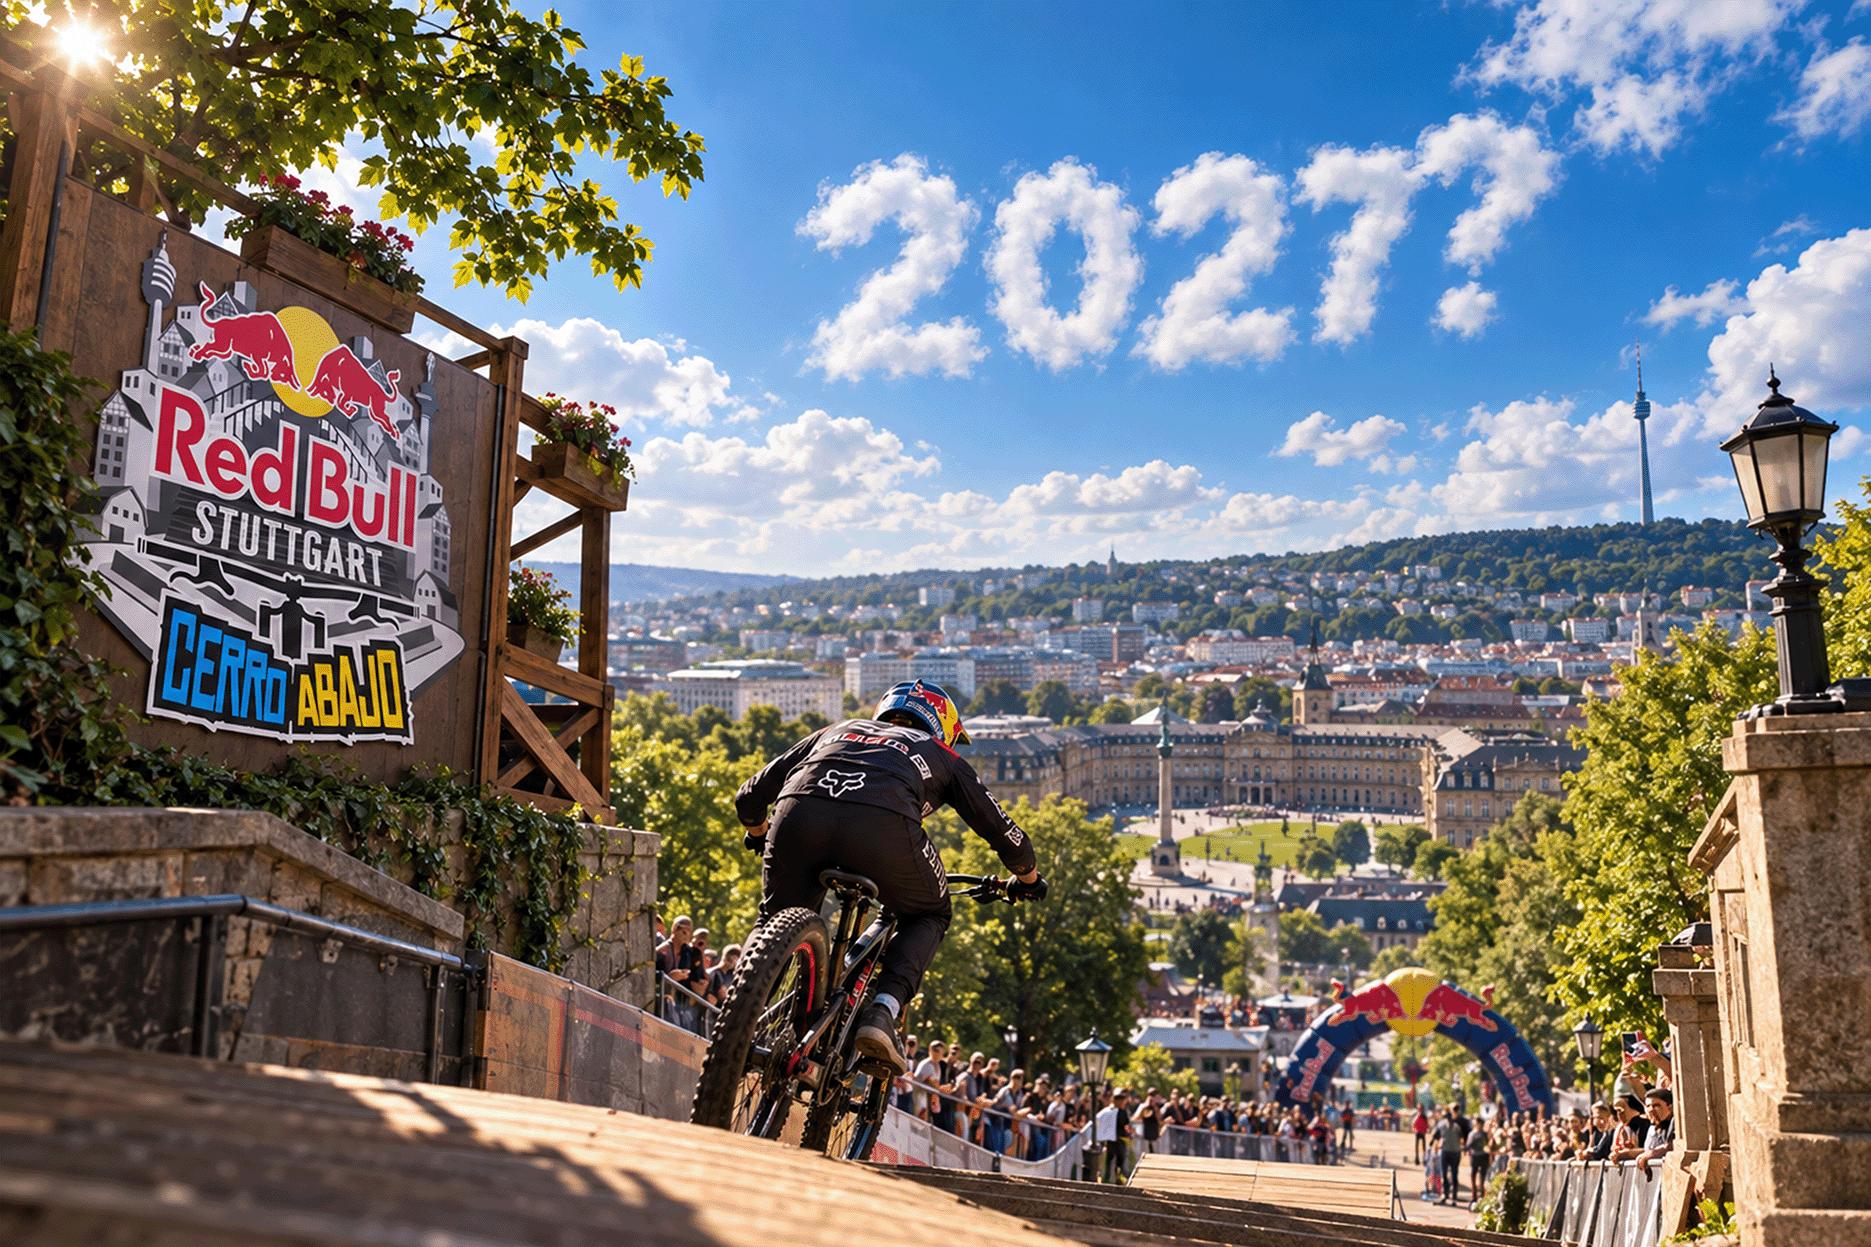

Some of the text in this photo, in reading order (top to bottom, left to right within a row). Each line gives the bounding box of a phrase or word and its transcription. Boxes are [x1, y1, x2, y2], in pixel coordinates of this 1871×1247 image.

[155, 388, 416, 547] Red Bull
[193, 502, 382, 586] STUTTGART
[163, 609, 403, 728] CERRO ABAJO
